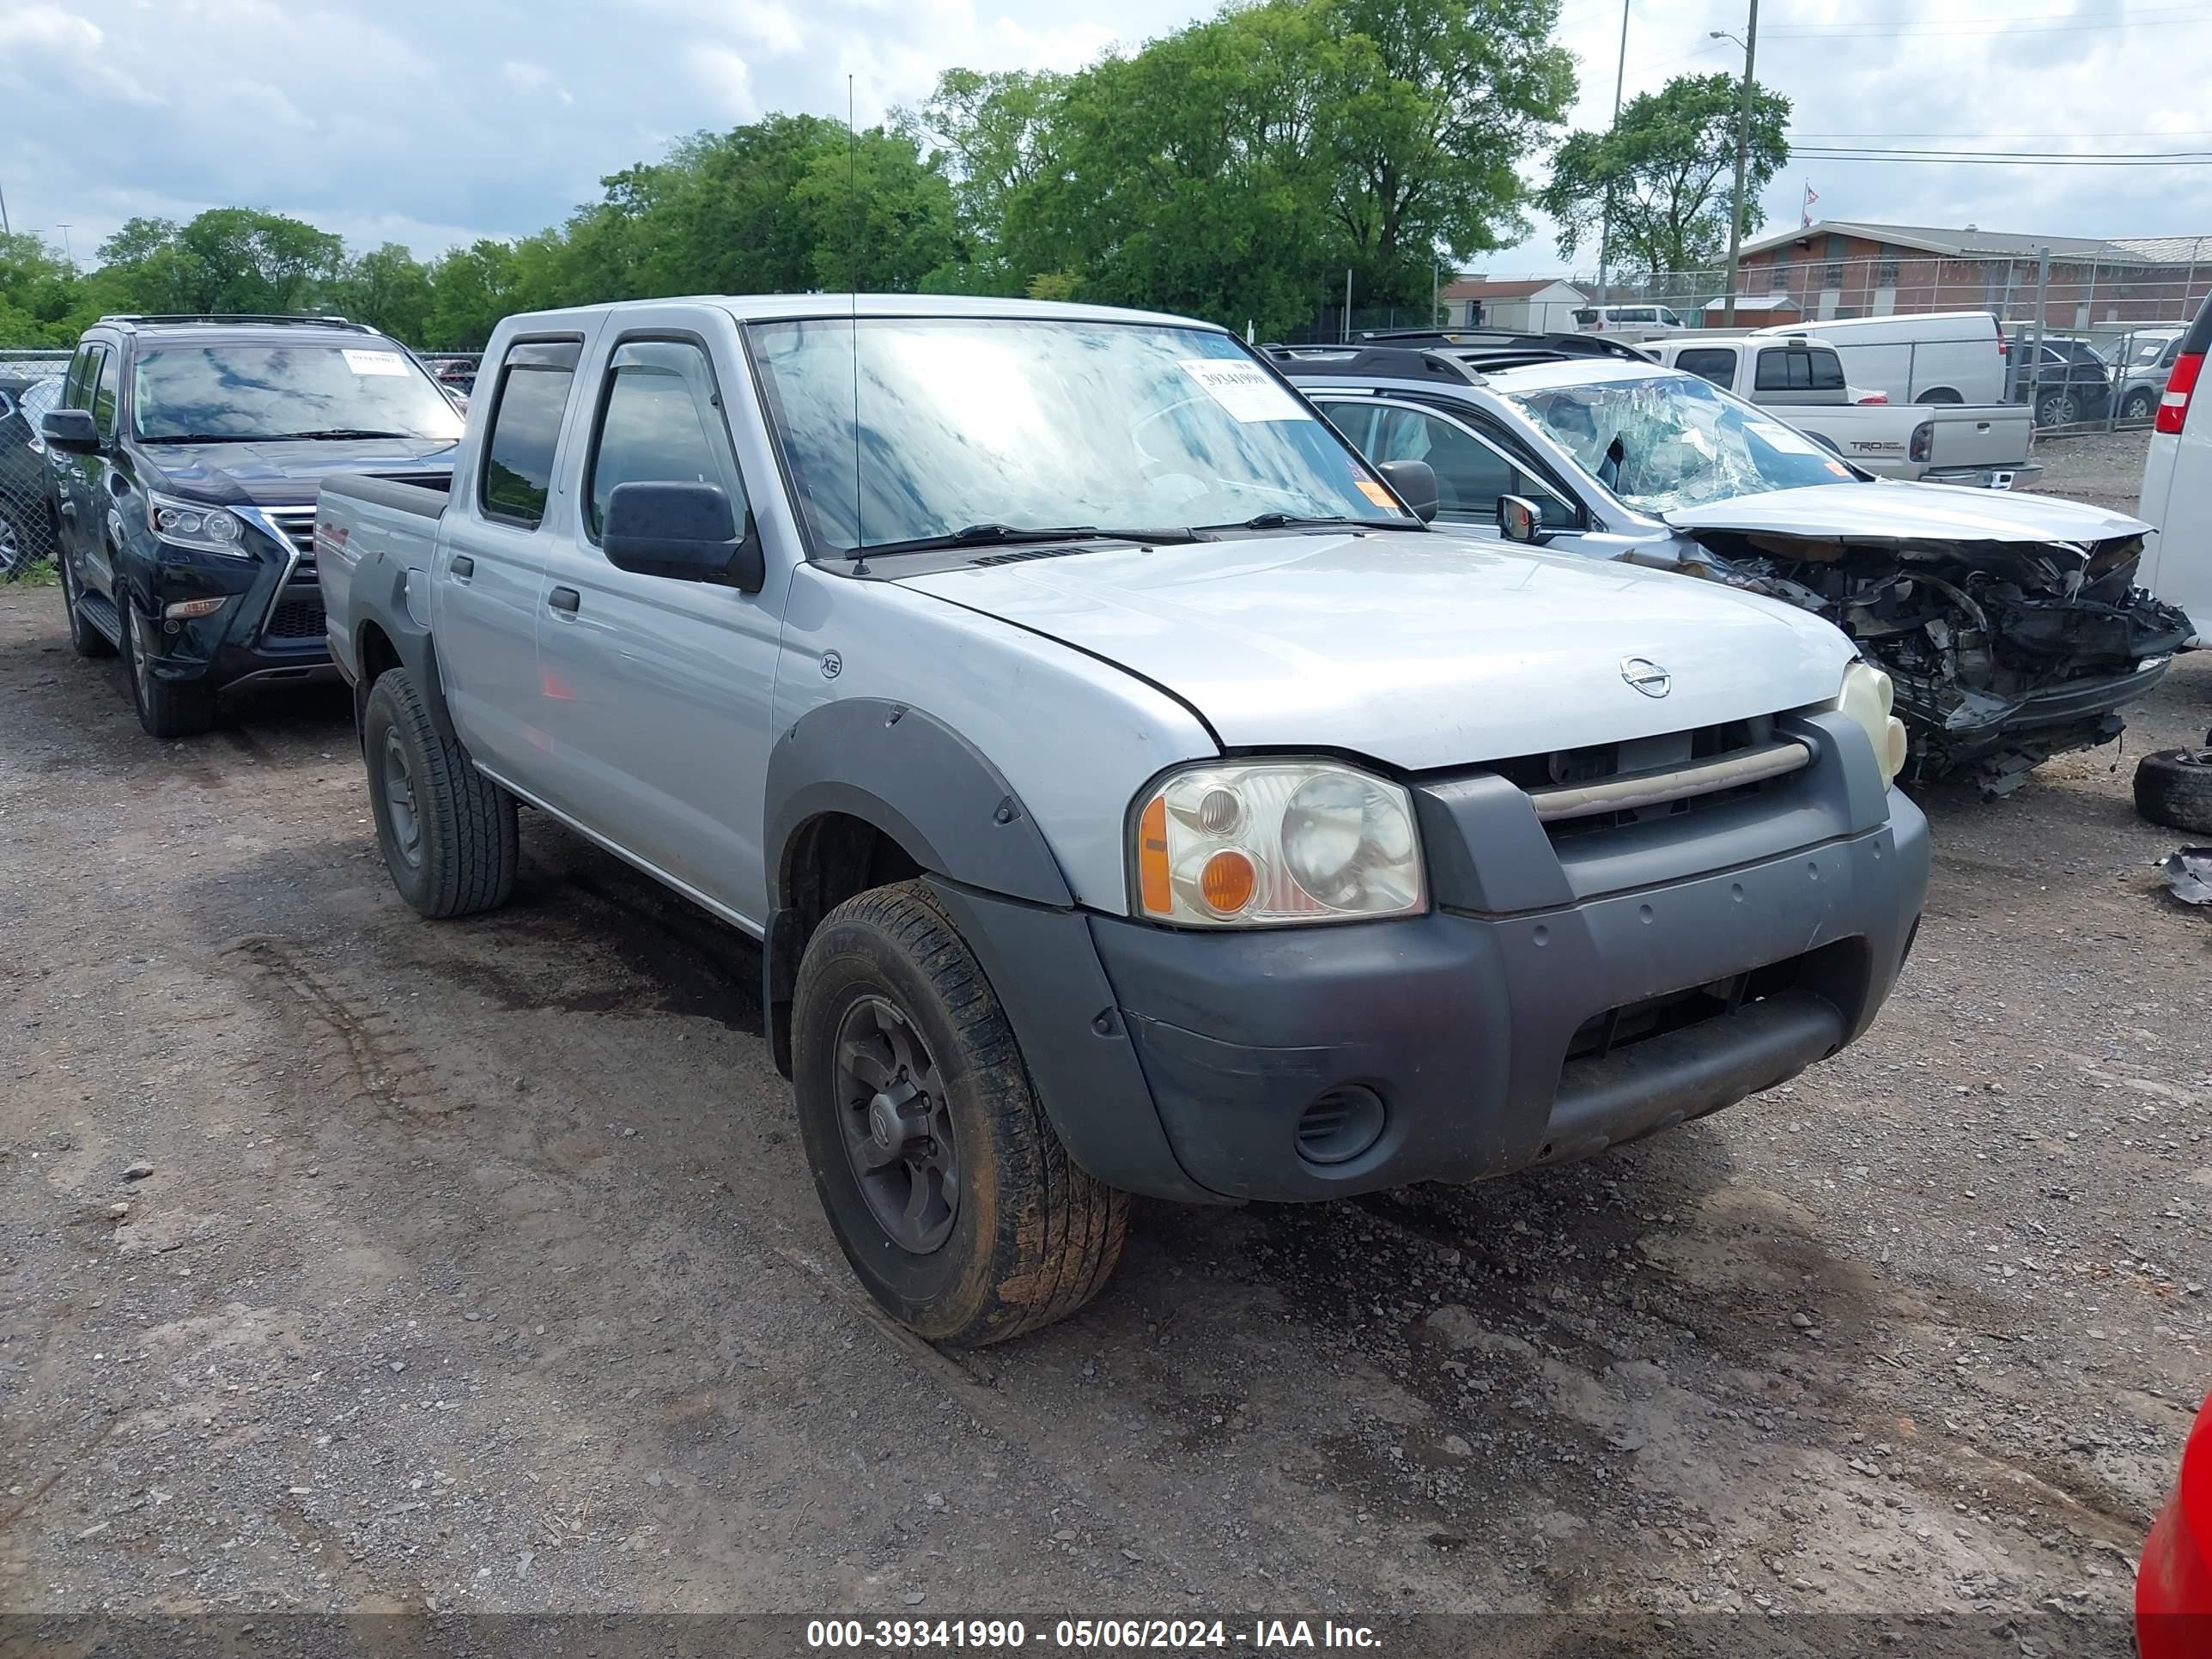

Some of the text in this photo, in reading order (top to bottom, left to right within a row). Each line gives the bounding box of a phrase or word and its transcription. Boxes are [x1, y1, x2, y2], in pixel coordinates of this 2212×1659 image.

[1201, 373, 1268, 386] 39341990
[1850, 441, 1882, 452] TRD
[822, 657, 839, 674] XE
[1629, 665, 1667, 678] NISS
